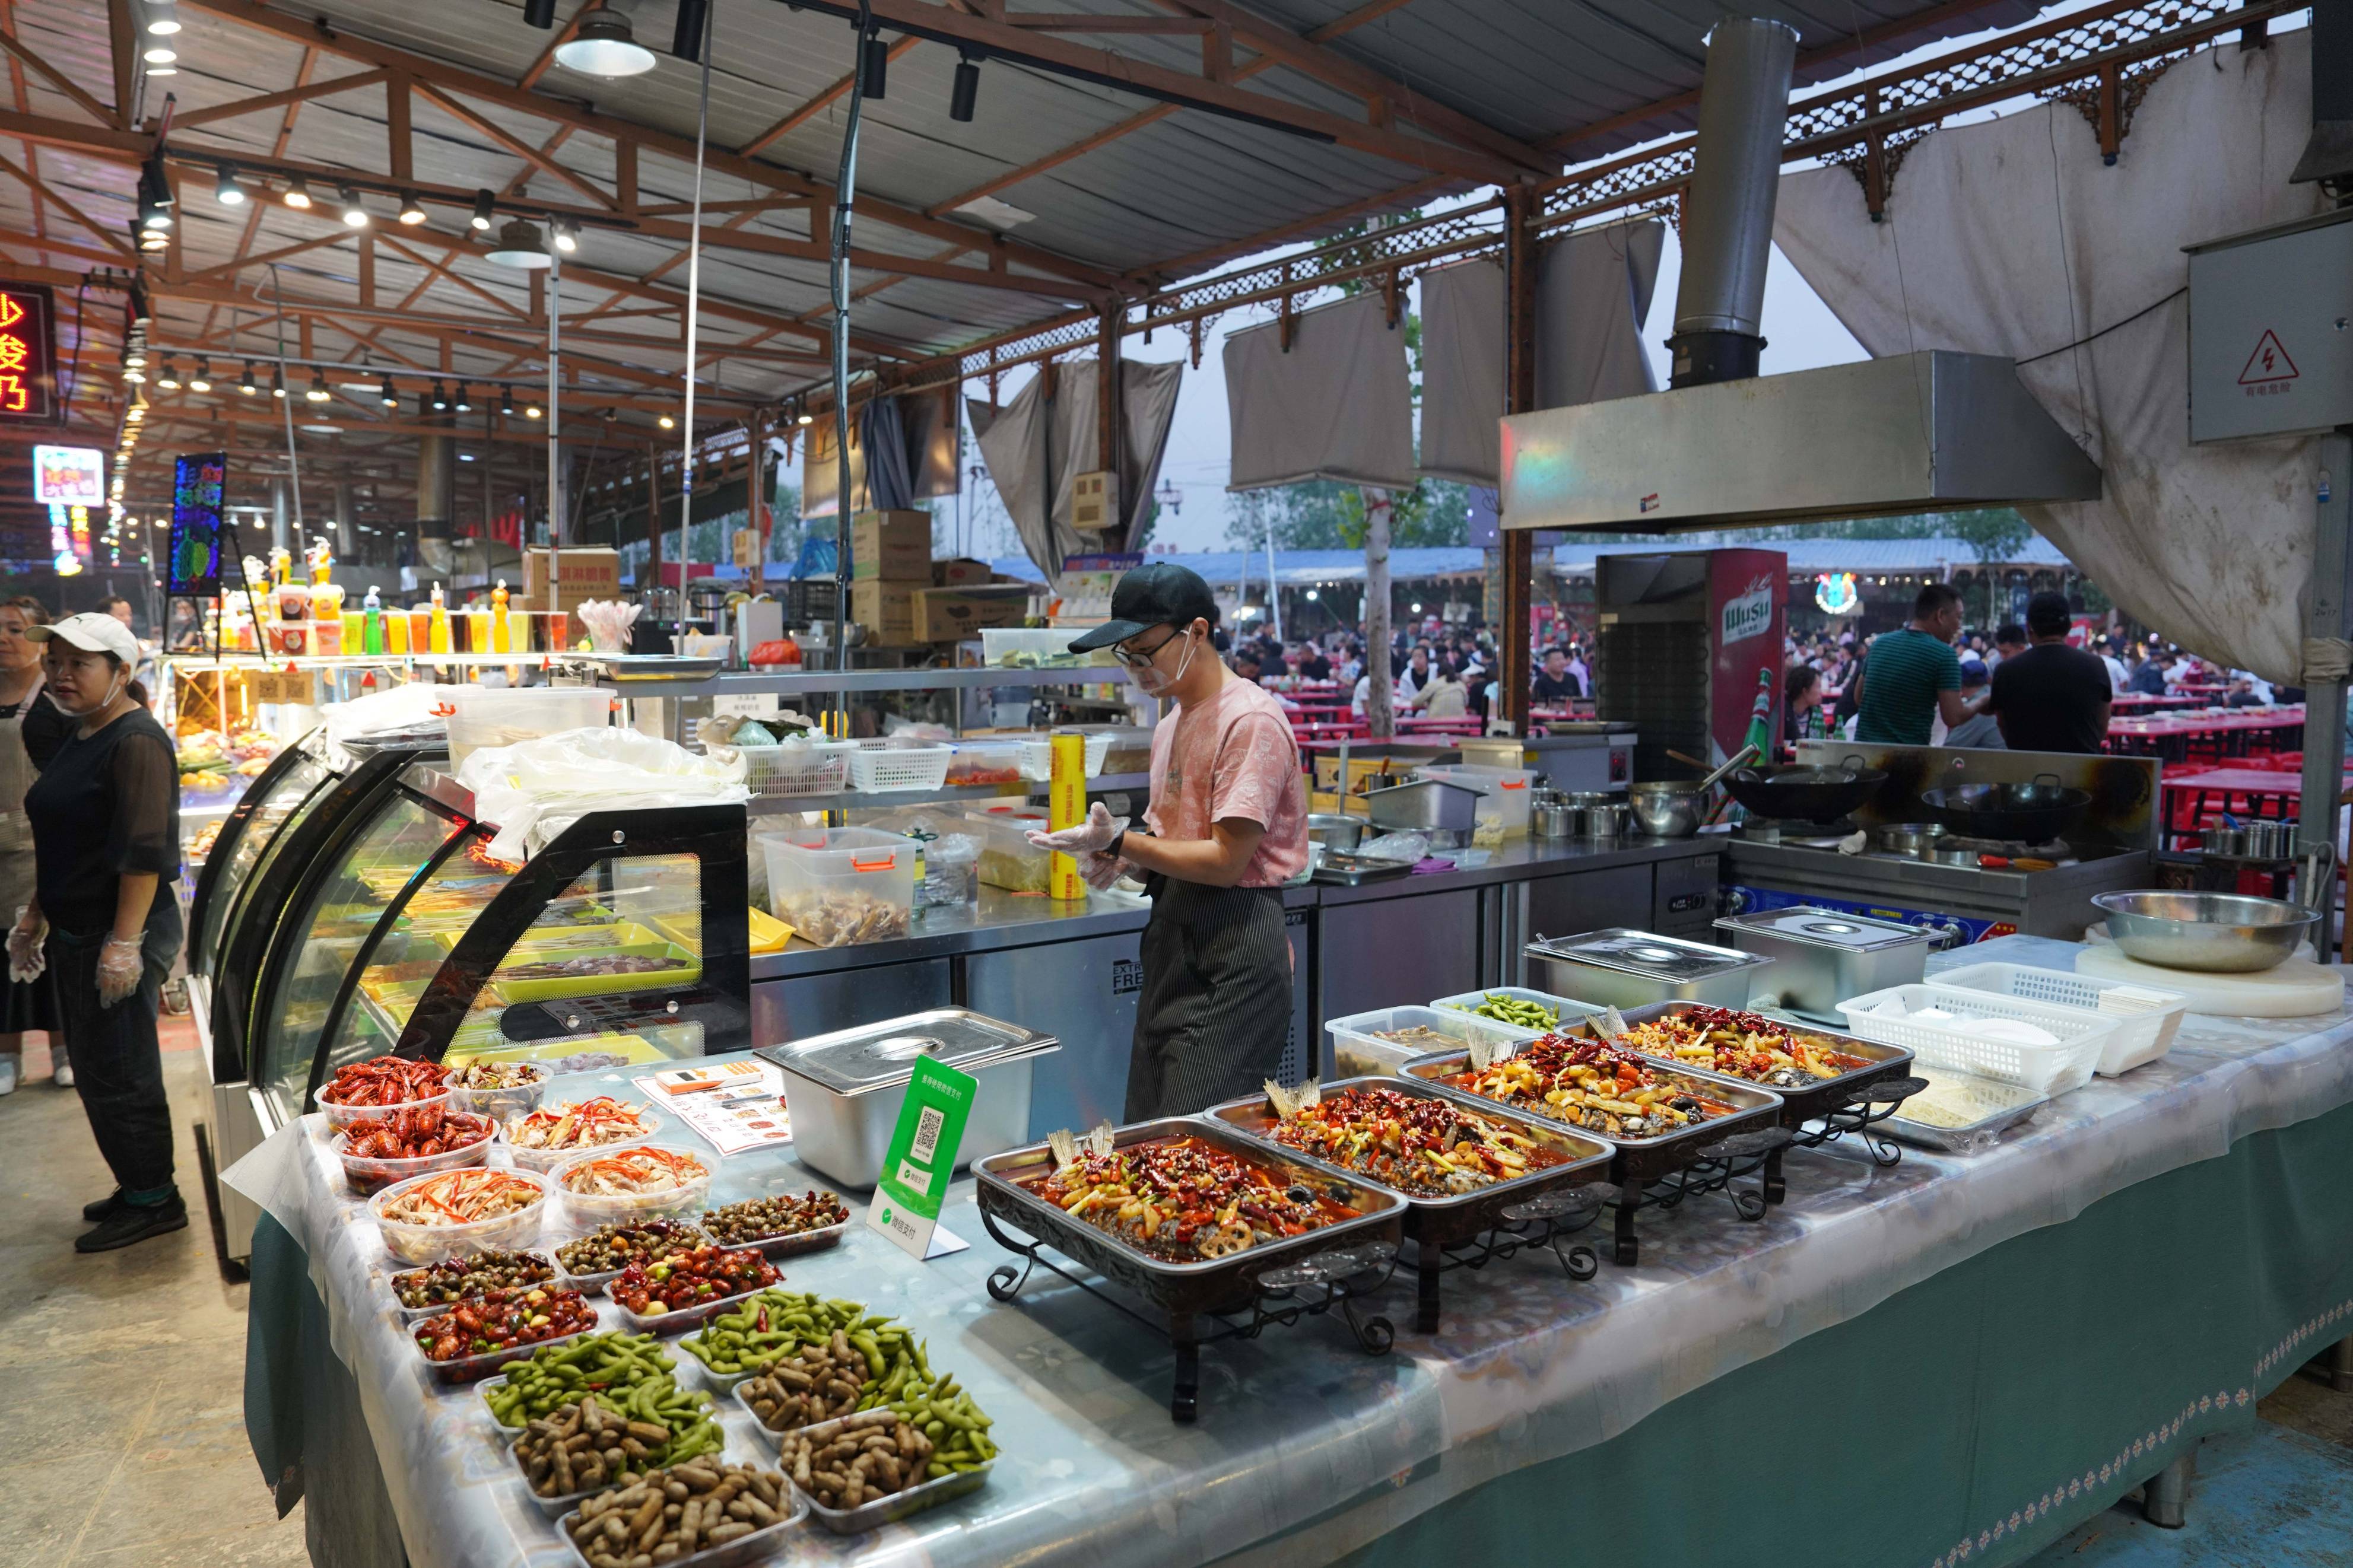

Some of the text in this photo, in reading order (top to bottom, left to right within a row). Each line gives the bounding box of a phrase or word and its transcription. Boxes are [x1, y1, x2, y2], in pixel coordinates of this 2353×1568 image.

[2246, 381, 2291, 397] 有电危险
[1113, 962, 1142, 975] EXTR
[1113, 972, 1144, 988] FRE
[921, 1074, 962, 1101] 推荐使用微信支付
[910, 1172, 926, 1187] 微信支付
[891, 1215, 916, 1241] 微信支付
